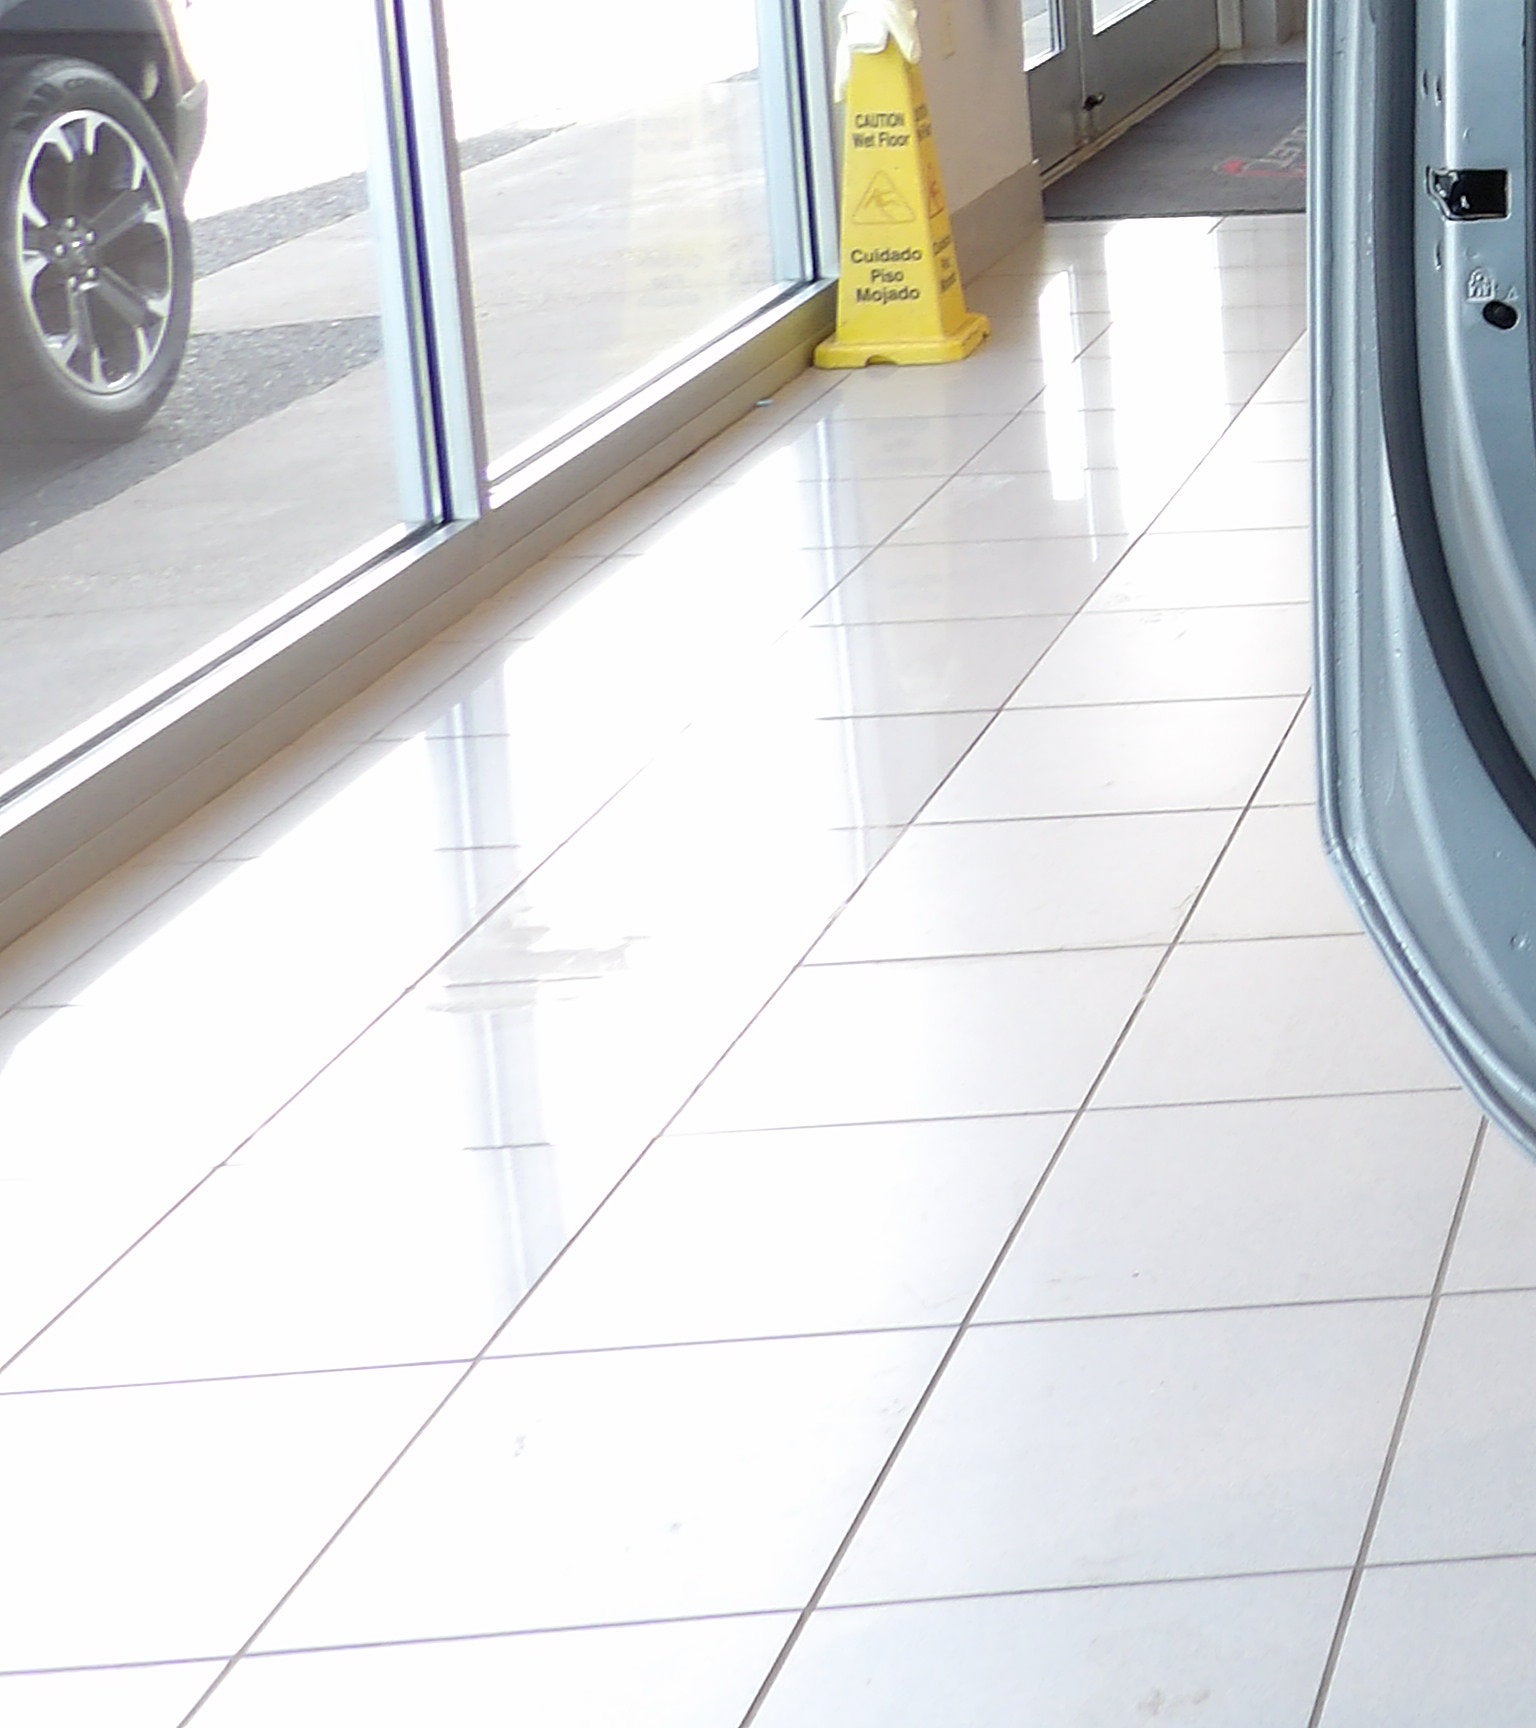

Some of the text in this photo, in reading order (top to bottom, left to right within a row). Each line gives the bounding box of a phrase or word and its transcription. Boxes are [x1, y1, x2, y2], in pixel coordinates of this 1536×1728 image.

[855, 113, 905, 129] CAUTION
[852, 132, 910, 148] Wet Floor
[850, 246, 923, 264] Cuidado
[870, 268, 904, 283] Piso
[856, 285, 921, 305] Mojado
